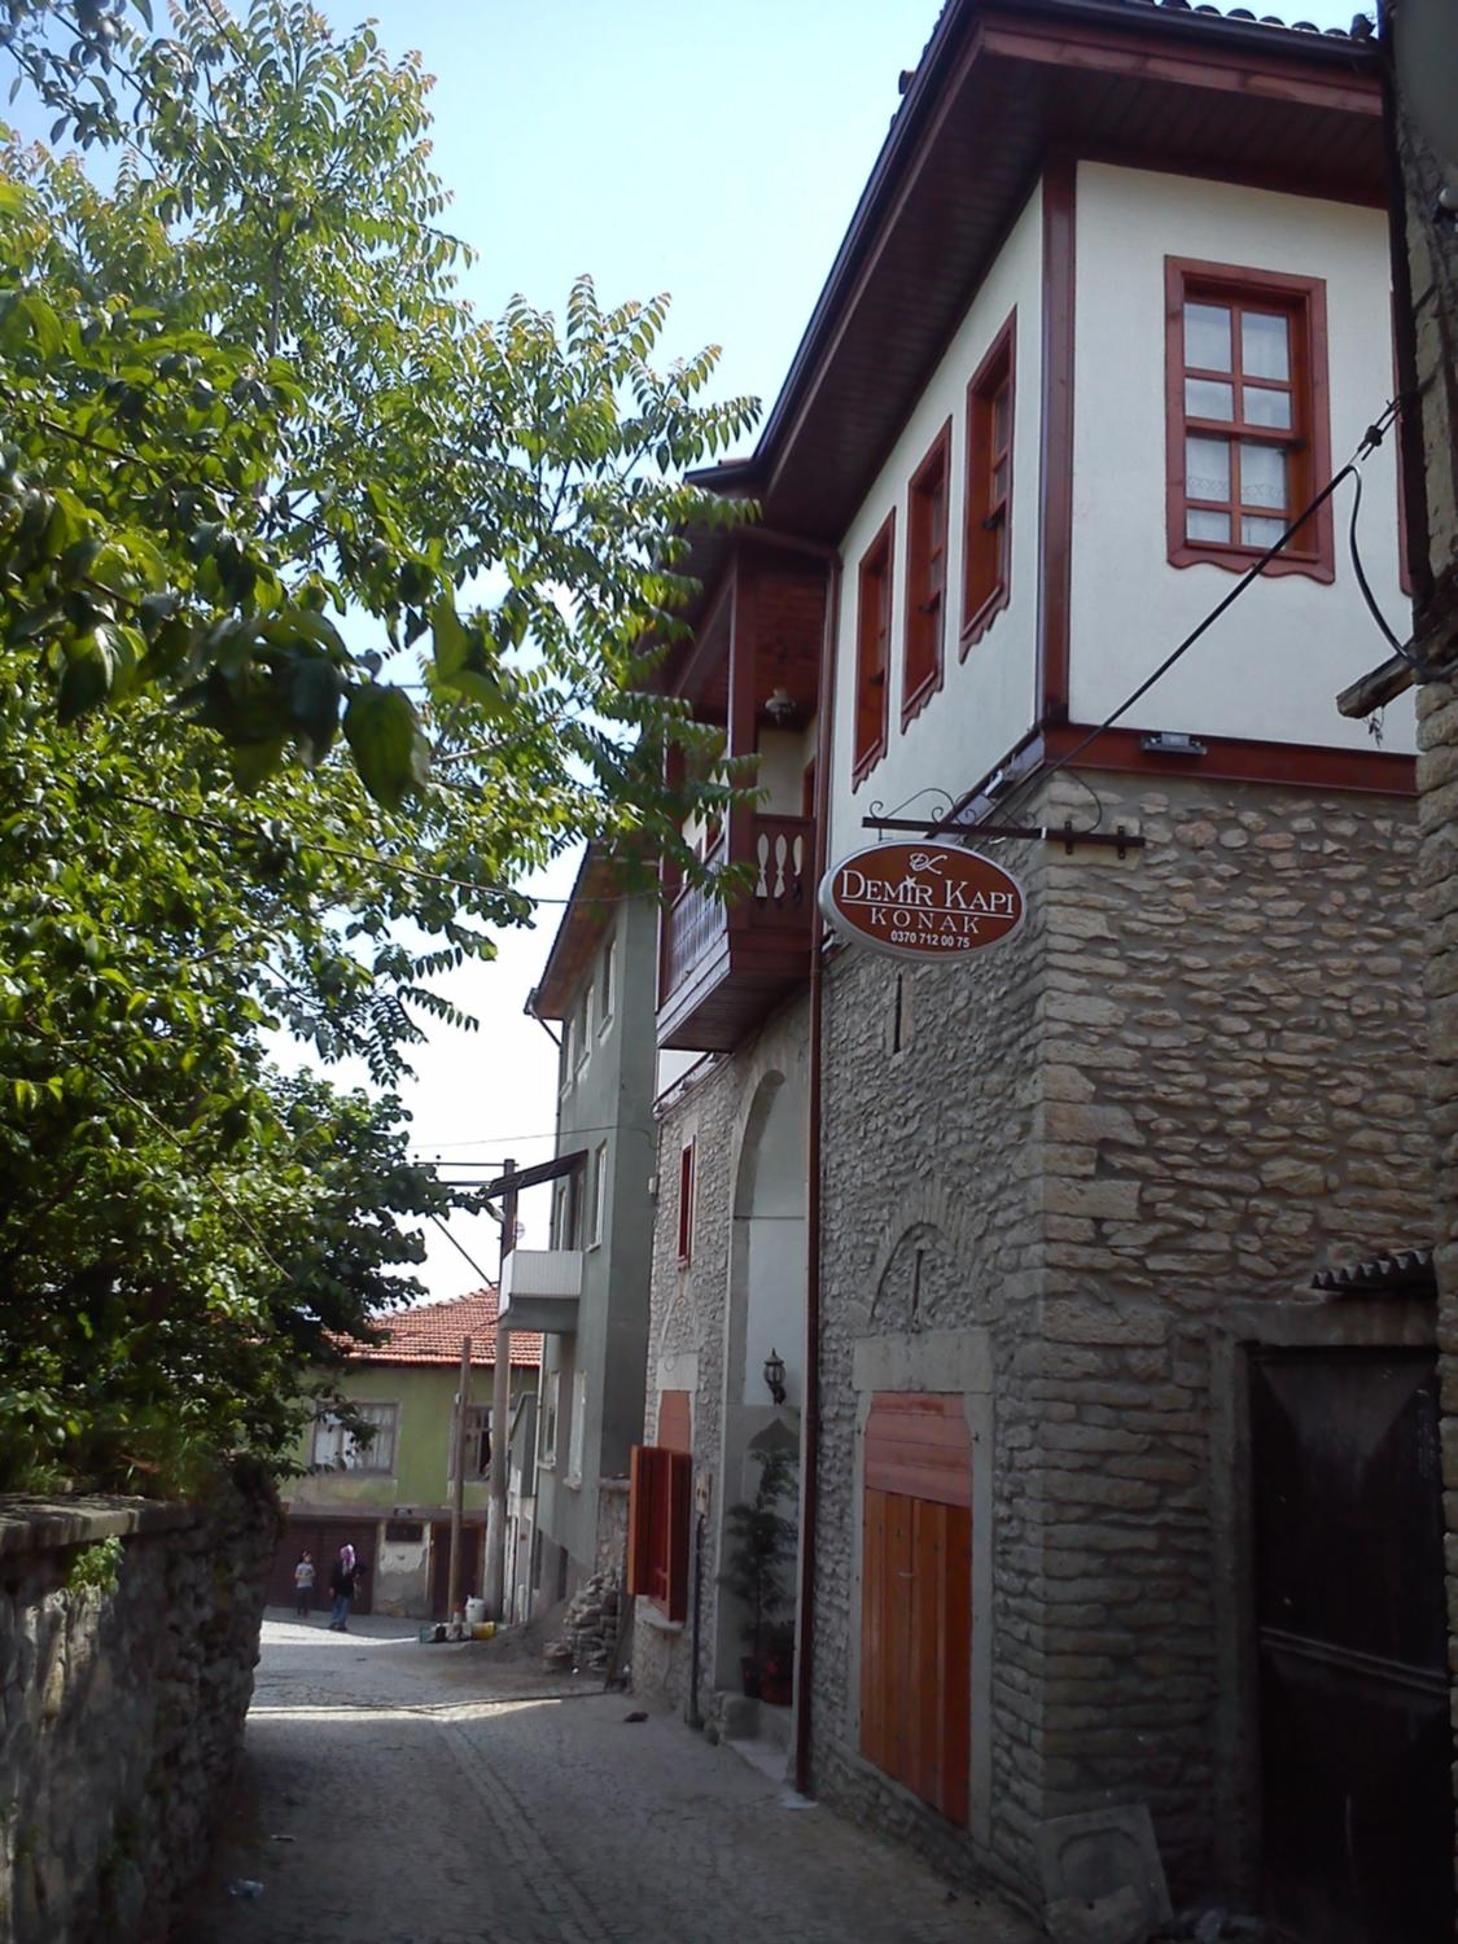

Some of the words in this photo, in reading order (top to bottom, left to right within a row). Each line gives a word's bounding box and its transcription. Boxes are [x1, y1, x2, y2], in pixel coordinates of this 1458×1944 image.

[944, 879, 1014, 914] KAPI
[870, 907, 980, 934] KONAK
[890, 929, 917, 943] 0370
[919, 932, 938, 945] 712
[940, 934, 954, 947] 00
[956, 936, 970, 949] 75
